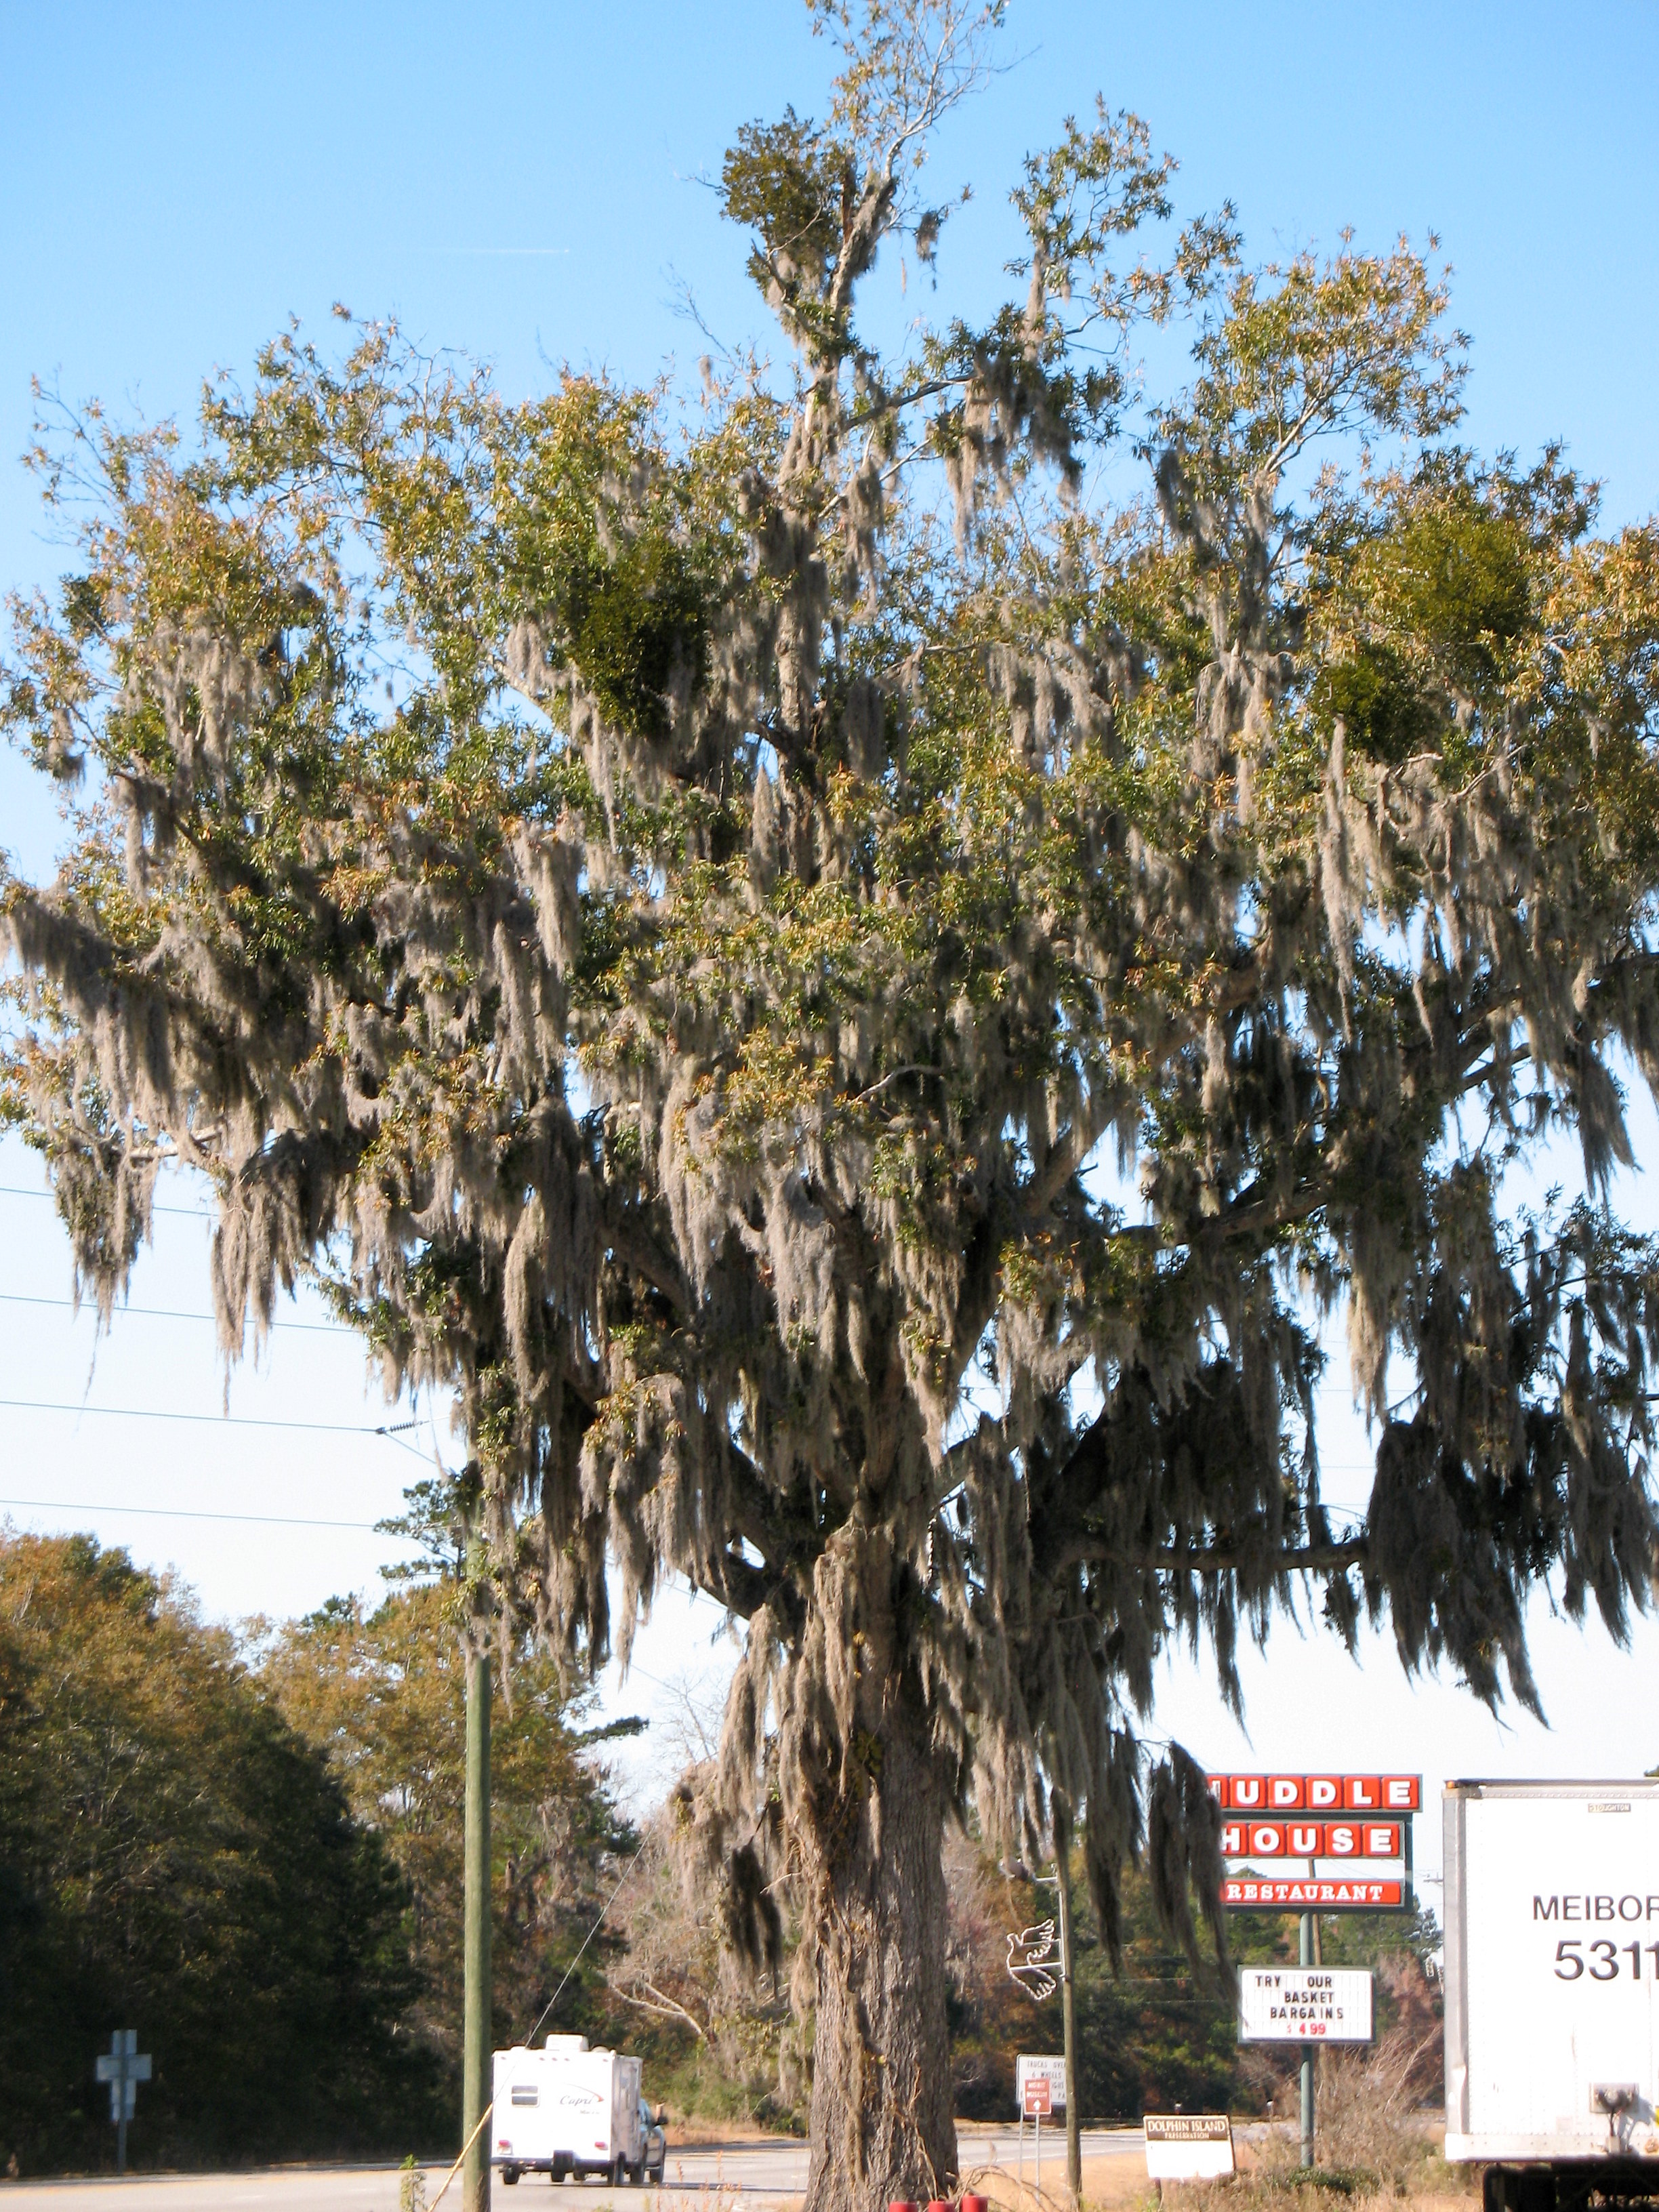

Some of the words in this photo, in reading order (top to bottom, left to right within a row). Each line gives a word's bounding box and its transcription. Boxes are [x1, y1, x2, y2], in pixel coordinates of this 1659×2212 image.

[1222, 1827, 1392, 1853] HOUSE
[1227, 1884, 1383, 1900] RESTAURANT
[1256, 1975, 1281, 1987] TRY
[1307, 1975, 1332, 1988] OUR
[1284, 1992, 1334, 2003] BASKET
[1270, 2007, 1344, 2019] BARGAINS
[560, 2095, 593, 2106] Capri
[1148, 2120, 1189, 2131] DOLPHIN
[1191, 2120, 1225, 2131] ISLAND
